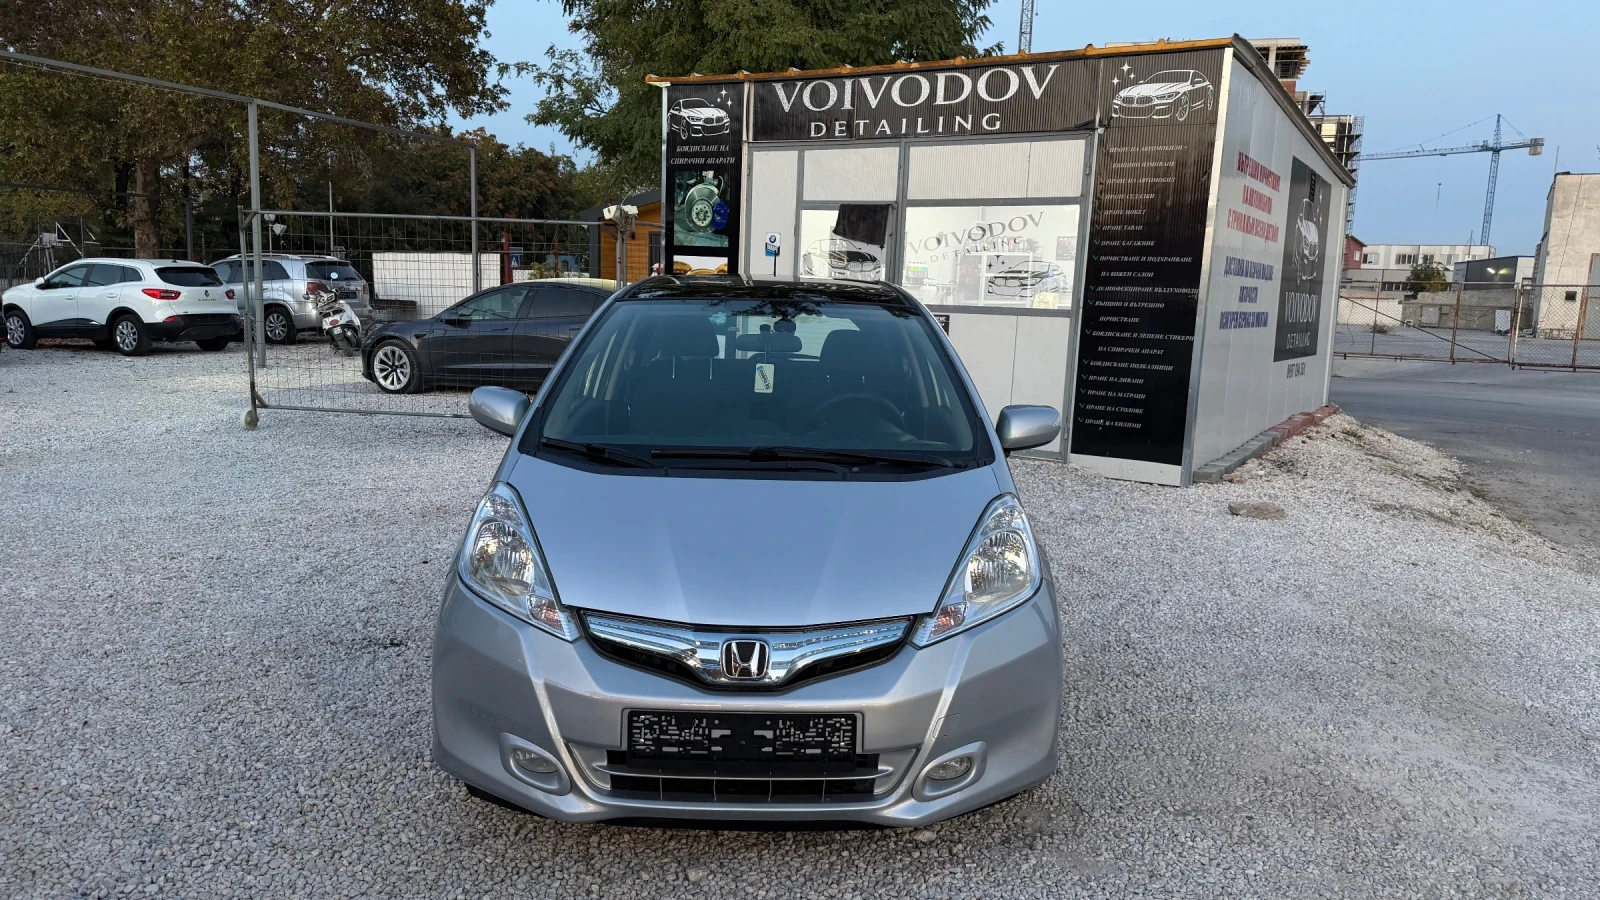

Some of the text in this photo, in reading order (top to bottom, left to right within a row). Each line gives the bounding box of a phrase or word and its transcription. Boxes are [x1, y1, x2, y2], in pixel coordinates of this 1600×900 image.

[772, 64, 1060, 113] VOIVODOV
[810, 113, 1001, 138] DETAILING
[670, 157, 705, 165] СПИРАЧНИ
[676, 144, 719, 153] БОЯДИСВАНЕ
[908, 211, 1045, 254] VOIVODOV
[930, 237, 1023, 263] DETAILING
[1284, 292, 1318, 324] VOIVODOV
[1286, 332, 1310, 348] DETAILING
[1090, 360, 1129, 368] БОЯДИСВАНЕ
